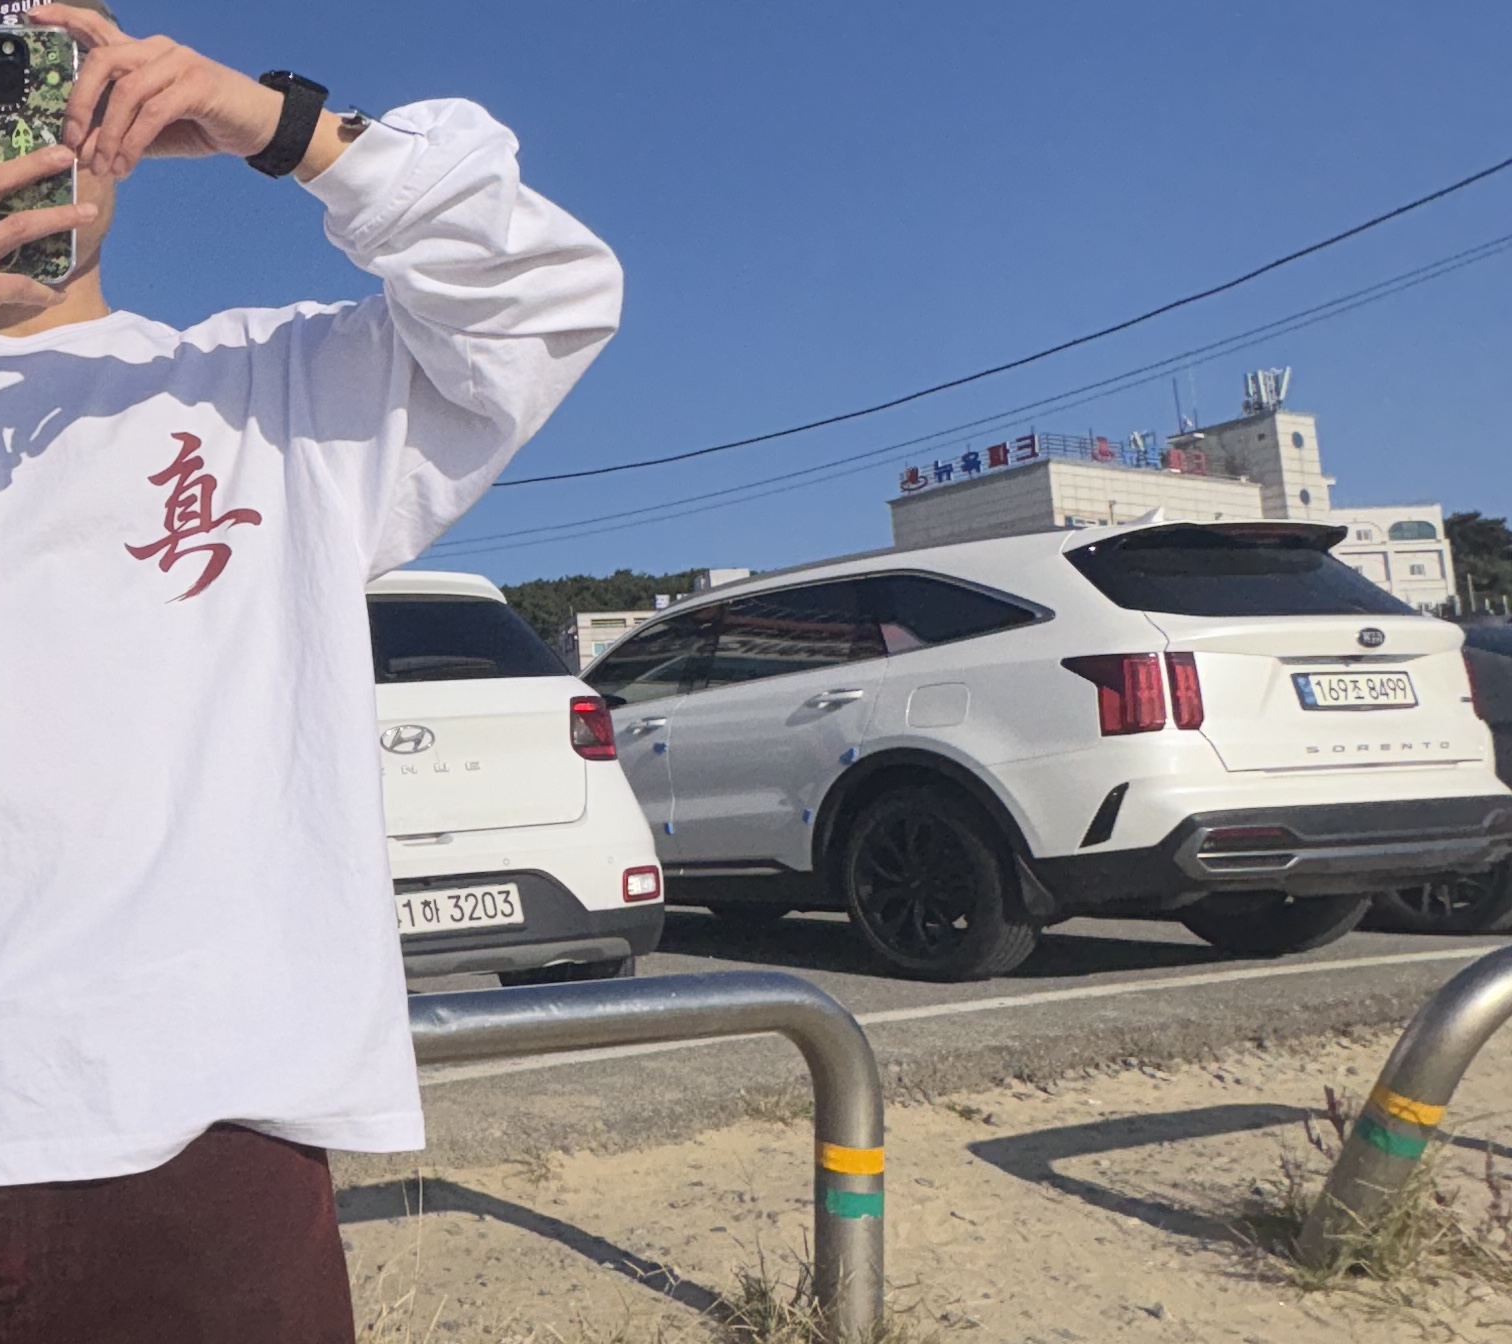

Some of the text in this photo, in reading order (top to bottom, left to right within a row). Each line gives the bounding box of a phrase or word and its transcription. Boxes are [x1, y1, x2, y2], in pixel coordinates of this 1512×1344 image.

[1315, 678, 1407, 702] 169조 8499
[1305, 741, 1450, 754] SORENTO
[381, 761, 481, 776] NUE
[396, 889, 515, 929] 1하 3203
